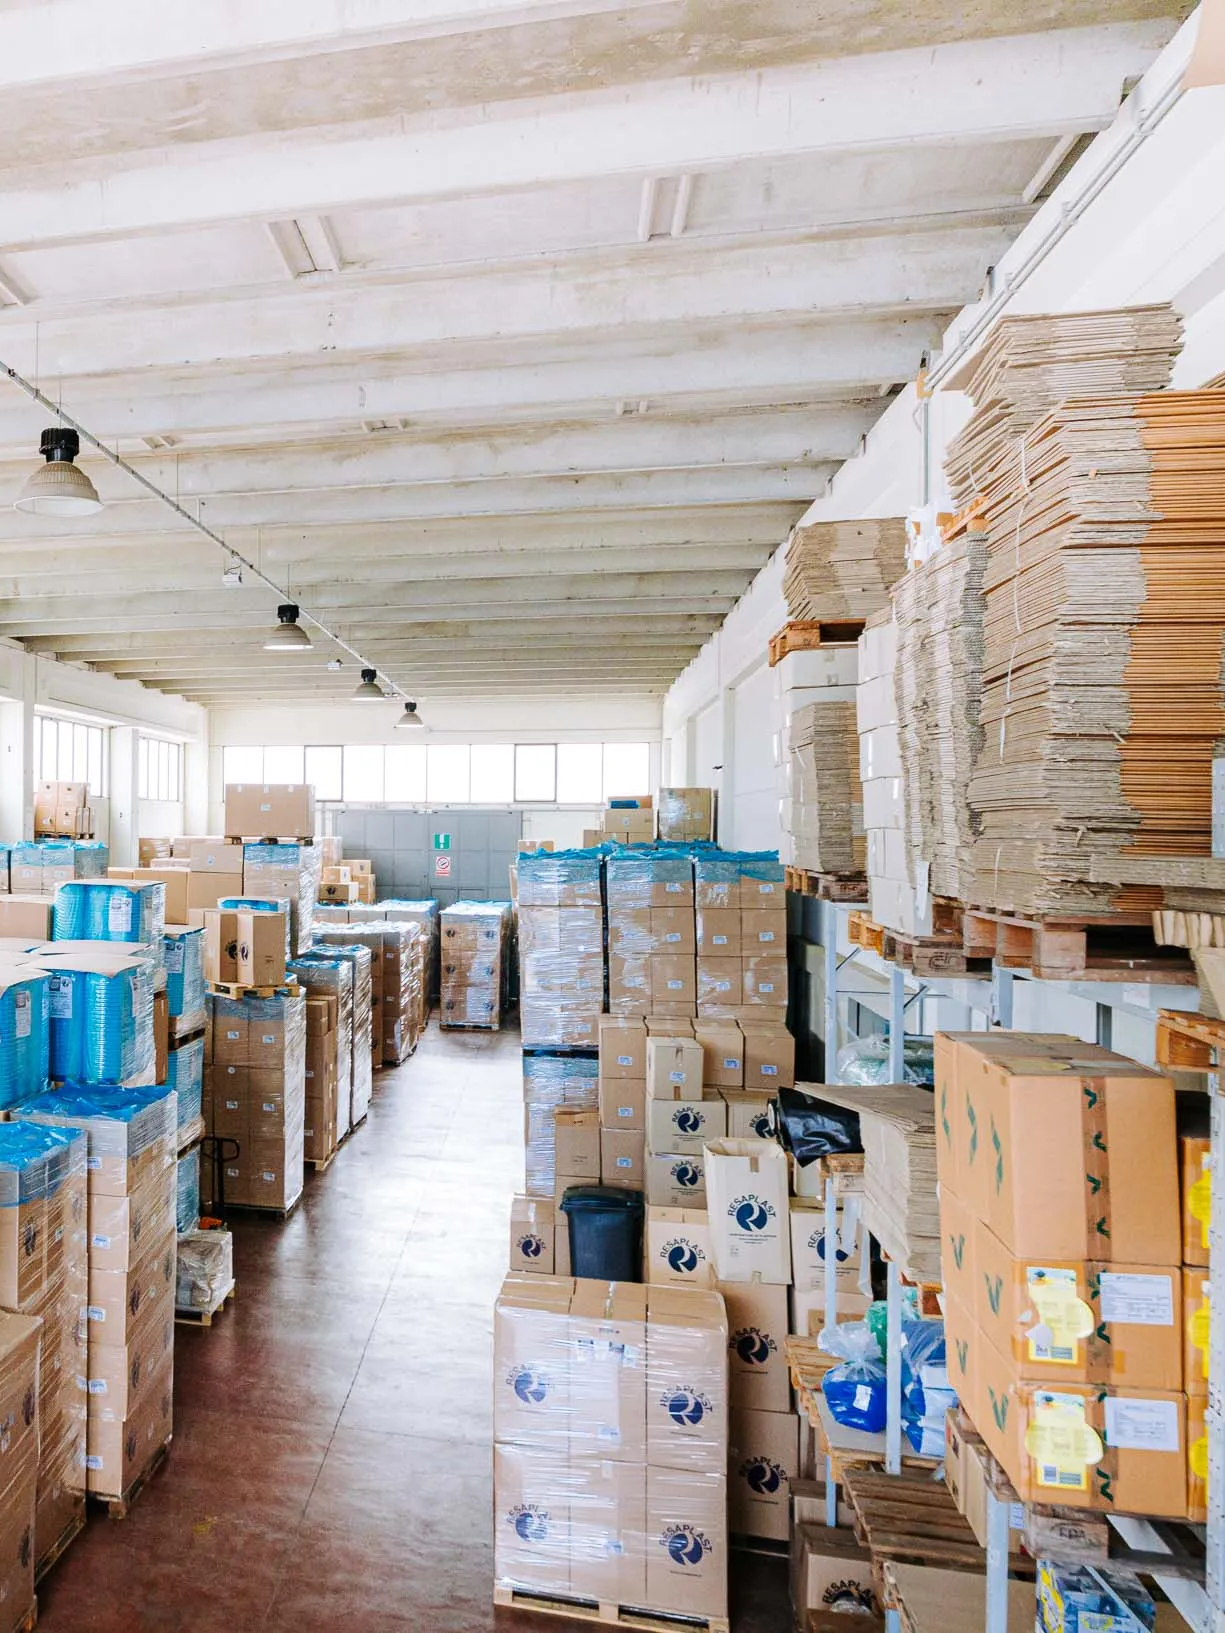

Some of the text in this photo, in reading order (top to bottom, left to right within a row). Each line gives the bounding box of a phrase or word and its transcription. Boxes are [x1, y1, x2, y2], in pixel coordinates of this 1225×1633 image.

[727, 1193, 777, 1218] RESAPLAST
[660, 1237, 706, 1262] RESAPLAST
[821, 1579, 874, 1606] RESAPLA
